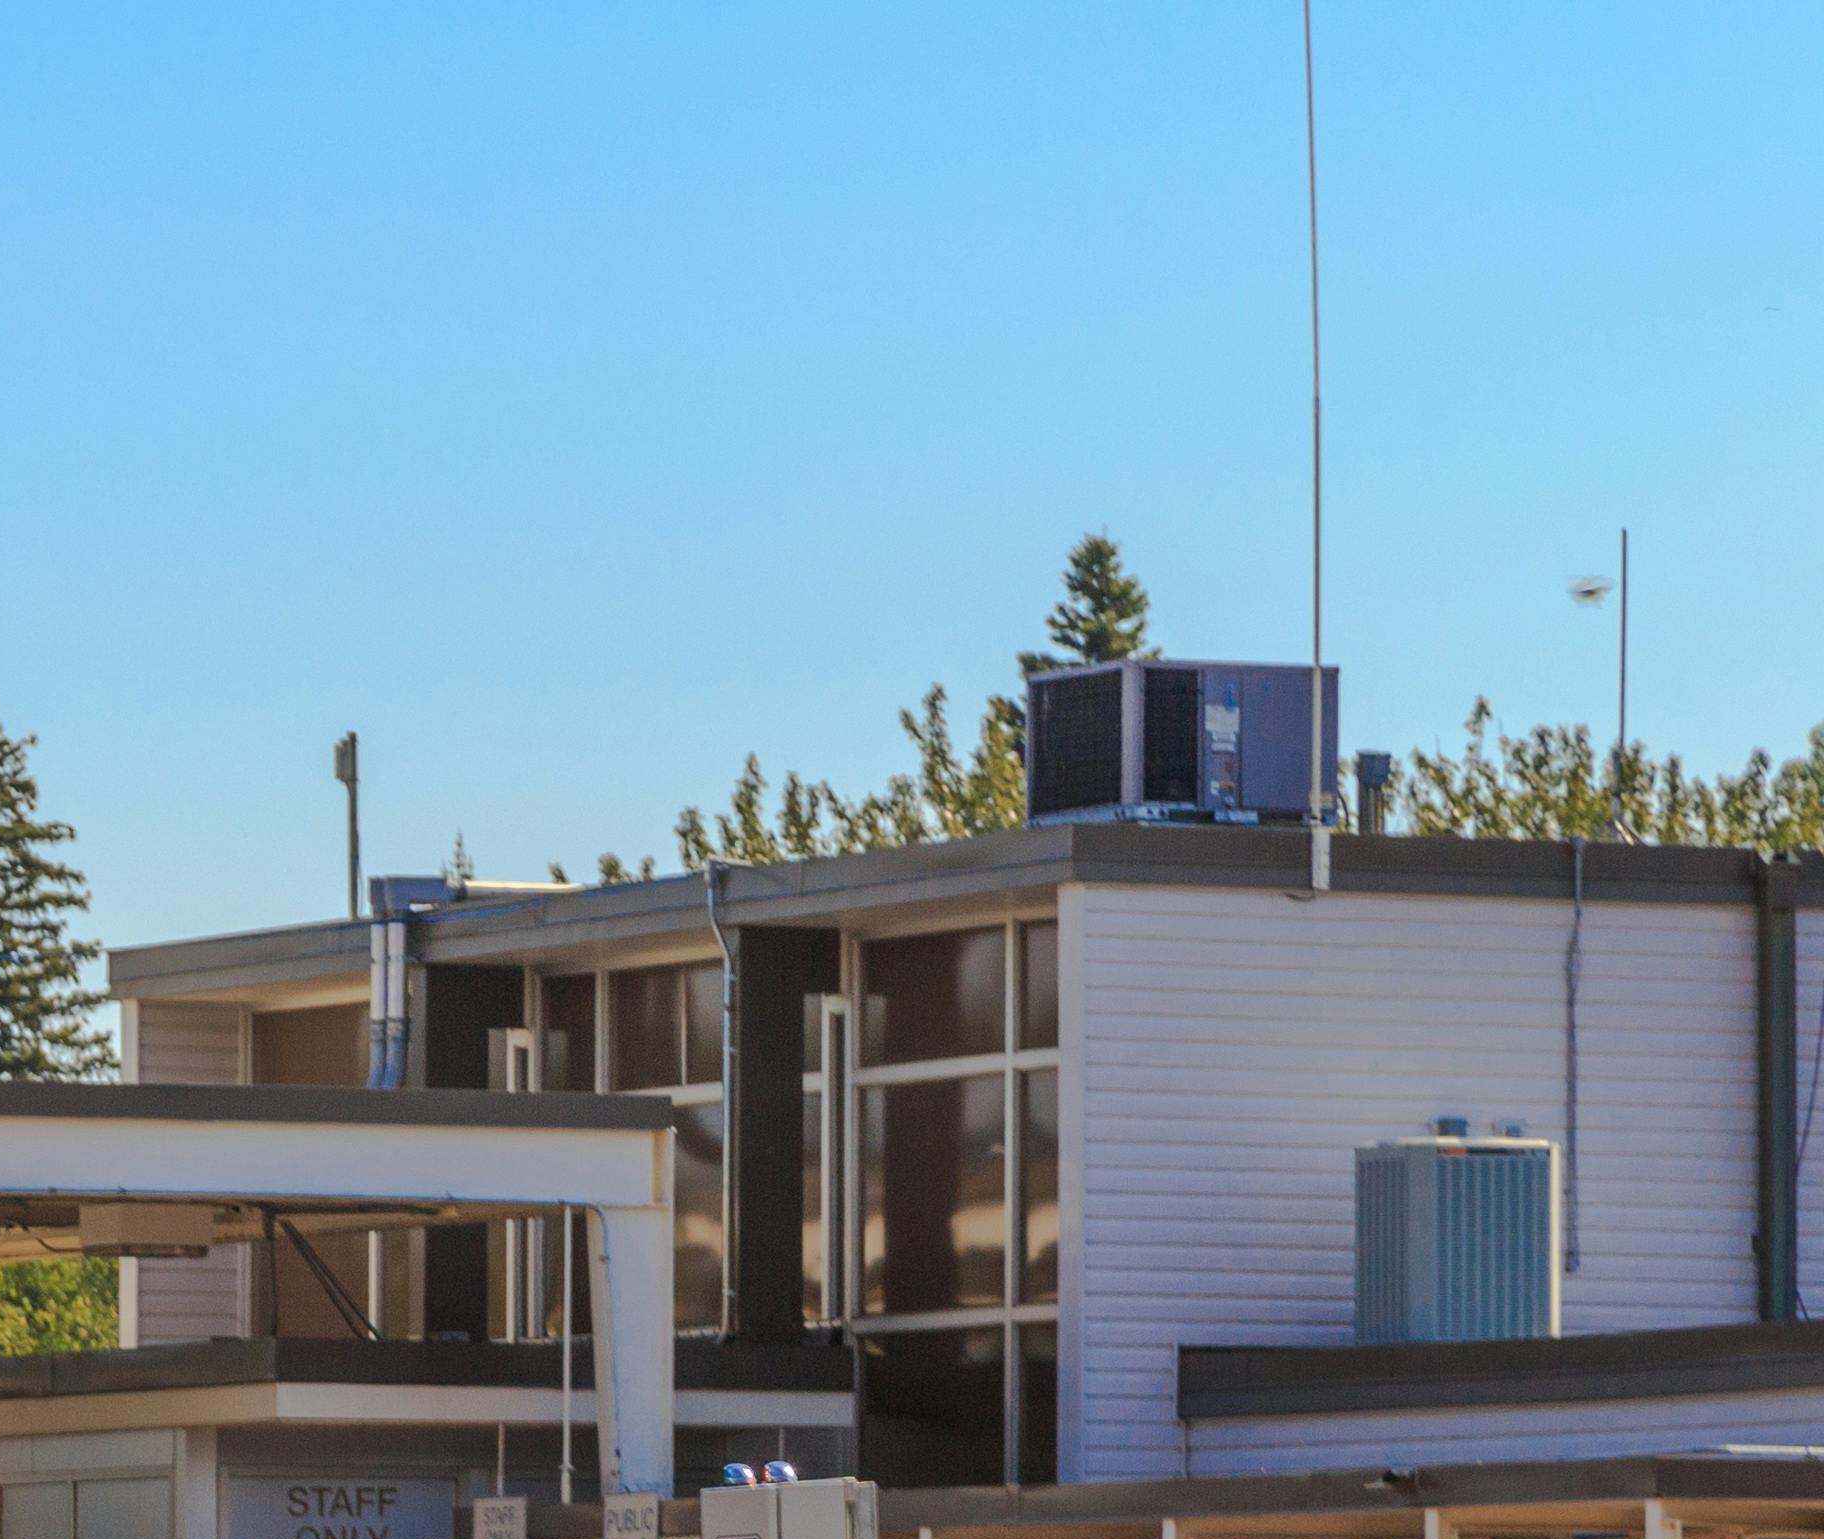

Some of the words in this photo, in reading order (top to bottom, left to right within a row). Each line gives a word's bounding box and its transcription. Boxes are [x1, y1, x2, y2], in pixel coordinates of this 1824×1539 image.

[288, 1486, 398, 1518] STAFF
[483, 1505, 515, 1525] STAFF
[606, 1507, 654, 1533] PUBLIC
